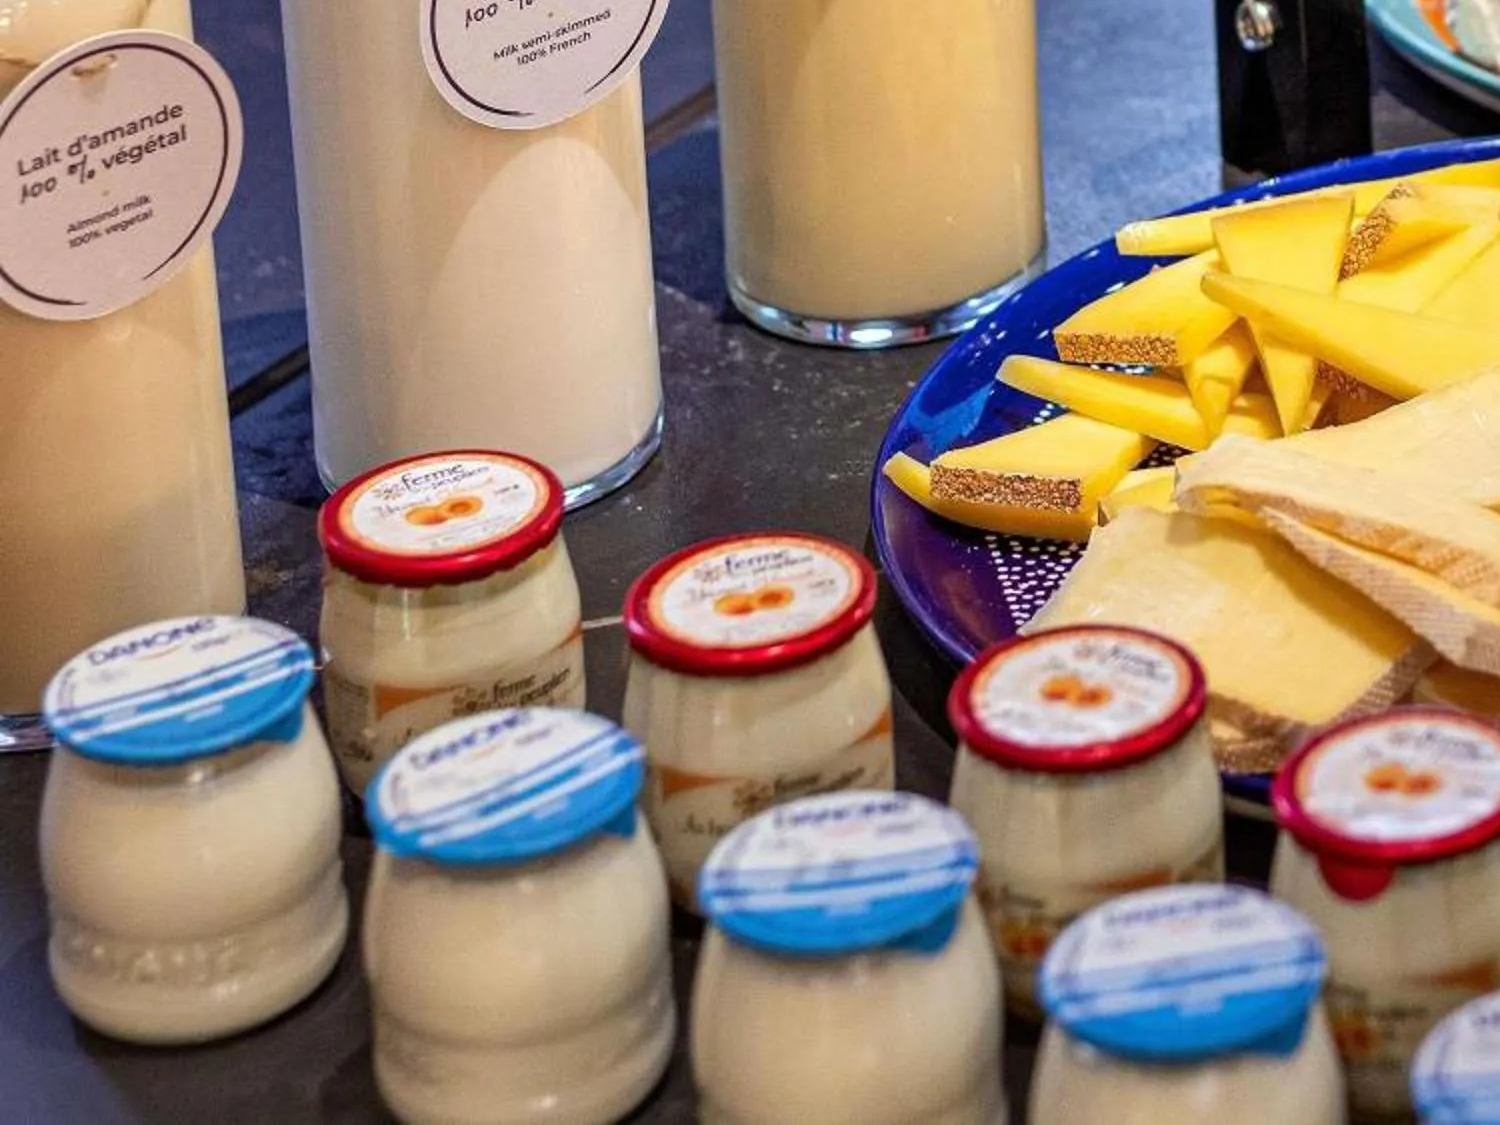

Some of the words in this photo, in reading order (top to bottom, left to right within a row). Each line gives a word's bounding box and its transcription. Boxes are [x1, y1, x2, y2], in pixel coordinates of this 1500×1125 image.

[493, 43, 519, 61] Milk
[522, 9, 612, 51] semi-skimmed
[516, 49, 547, 66] 100%
[549, 32, 592, 55] French
[17, 146, 62, 177] Lait
[67, 103, 183, 157] d'amande
[101, 124, 187, 171] végétal
[67, 203, 120, 234] Almond
[122, 194, 151, 214] milk
[68, 228, 102, 249] 100%
[104, 209, 153, 236] vegetal
